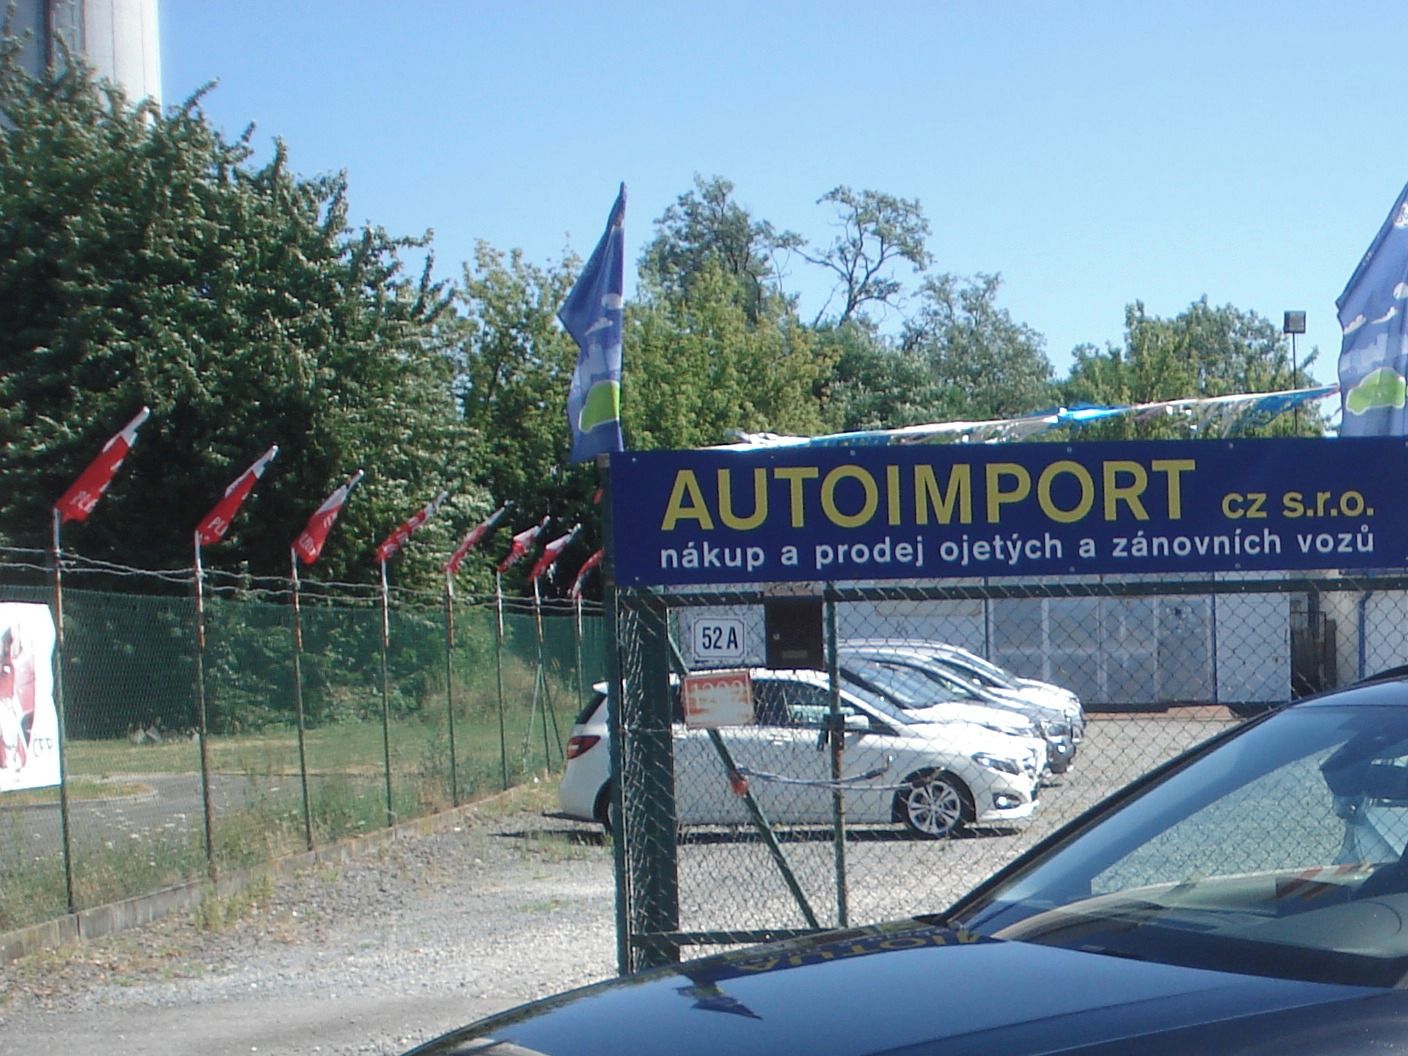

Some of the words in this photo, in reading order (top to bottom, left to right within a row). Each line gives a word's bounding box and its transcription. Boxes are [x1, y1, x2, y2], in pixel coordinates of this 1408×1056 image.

[661, 459, 1196, 531] AUTOIMPORT
[1221, 491, 1268, 519] cz
[1282, 490, 1374, 518] s.r.o.
[660, 540, 765, 572] nákup
[780, 544, 799, 565] a
[815, 534, 924, 570] prodej
[939, 532, 1063, 566] ojetých
[1078, 538, 1097, 558] a
[1112, 528, 1281, 558] zánovních
[1296, 524, 1374, 554] vozů
[702, 626, 722, 650] 52
[727, 626, 739, 650] A
